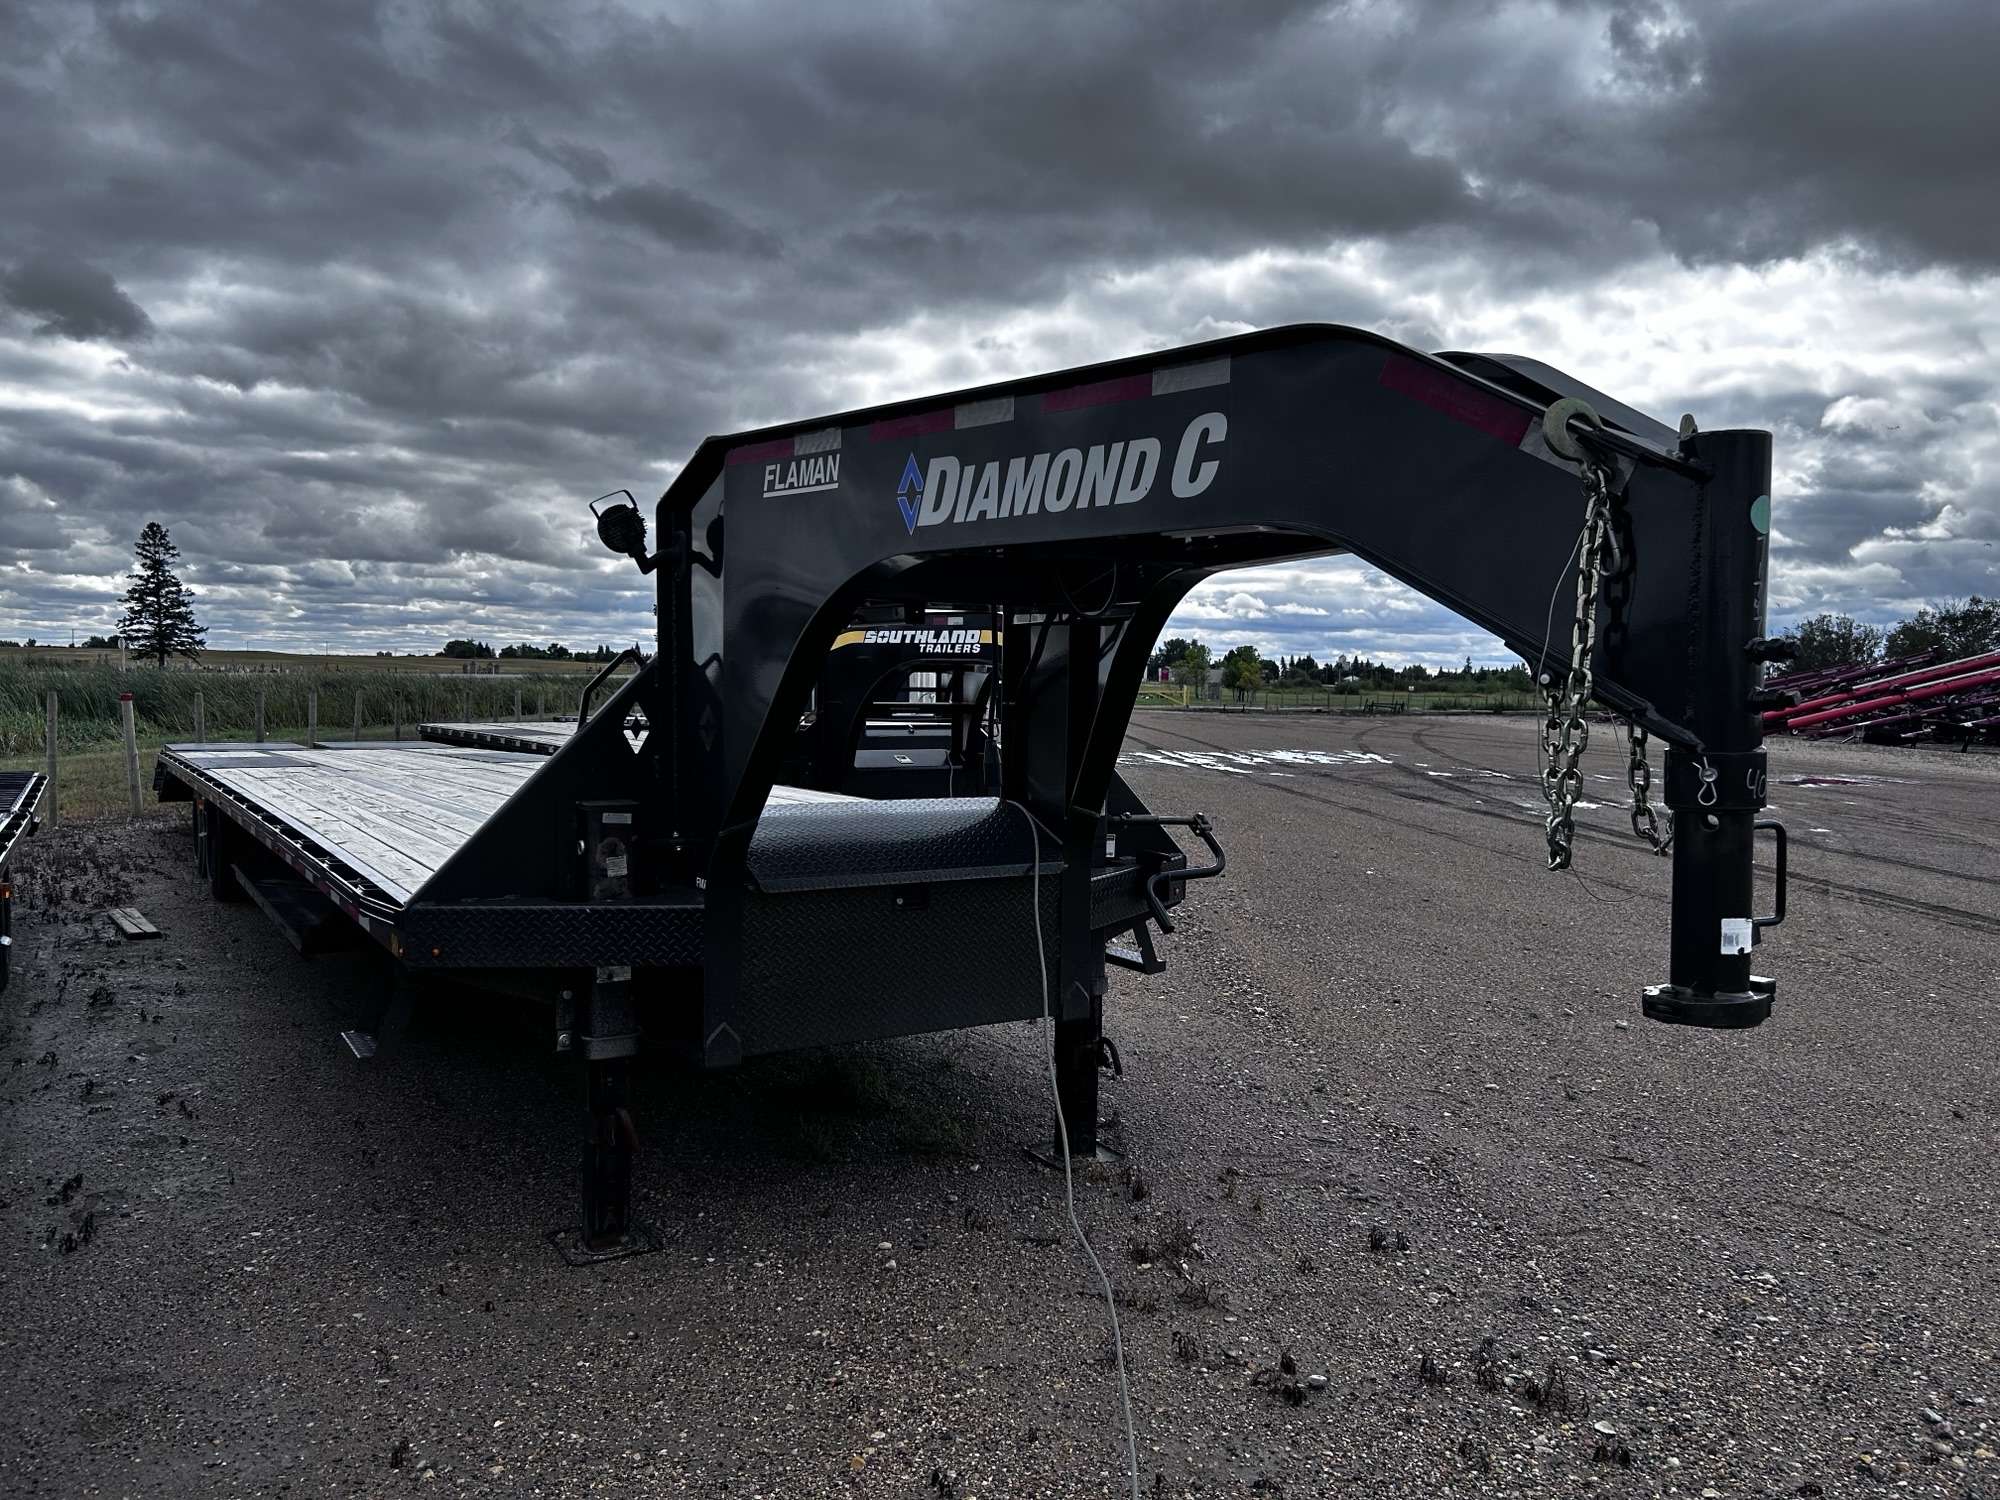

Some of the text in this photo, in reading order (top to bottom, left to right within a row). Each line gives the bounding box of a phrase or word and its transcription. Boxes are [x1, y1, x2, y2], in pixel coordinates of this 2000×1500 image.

[763, 454, 840, 492] FLAMAN
[917, 412, 1228, 527] DIAMOND C
[863, 629, 981, 644] SOUTHLAND
[919, 644, 981, 654] TRAILERS
